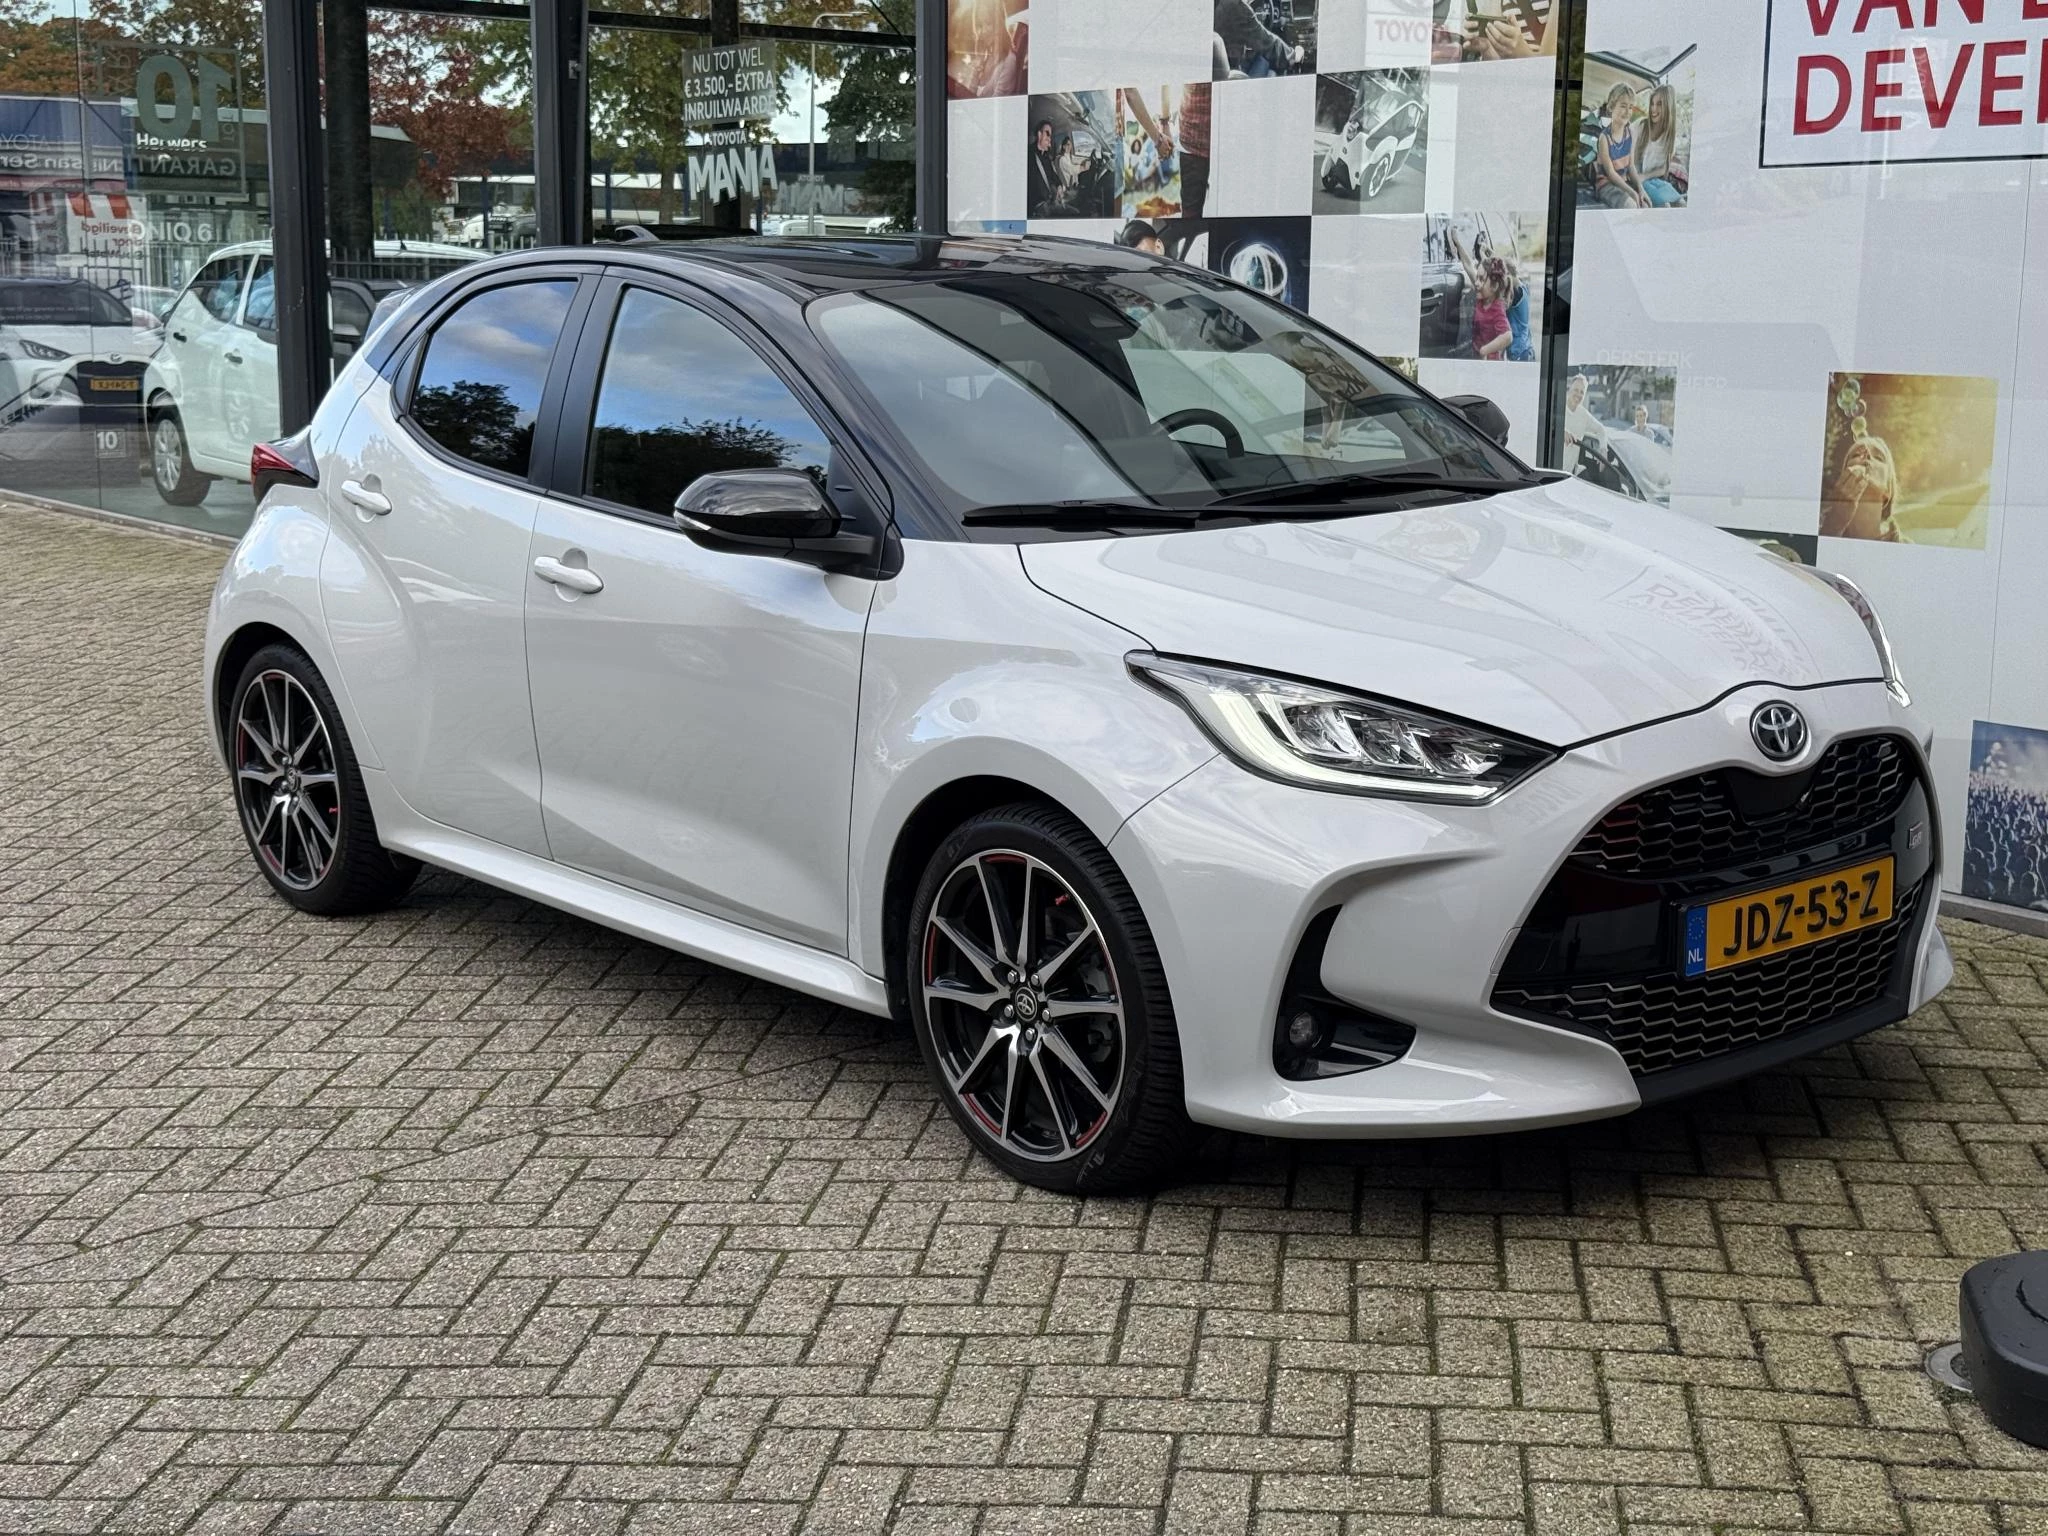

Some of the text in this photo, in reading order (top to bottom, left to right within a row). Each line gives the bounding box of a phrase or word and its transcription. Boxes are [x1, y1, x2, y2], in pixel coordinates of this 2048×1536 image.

[693, 46, 765, 74] NU TOT WEL
[735, 68, 775, 93] ÉXTRA
[1793, 38, 2048, 136] DEVE
[683, 94, 776, 121] INRUILWAARDE
[712, 130, 748, 146] TOYOTA
[688, 143, 779, 205] MANIA
[96, 430, 118, 450] 10
[1723, 870, 1881, 956] JDZ-53-Z
[1687, 949, 1704, 965] NL
